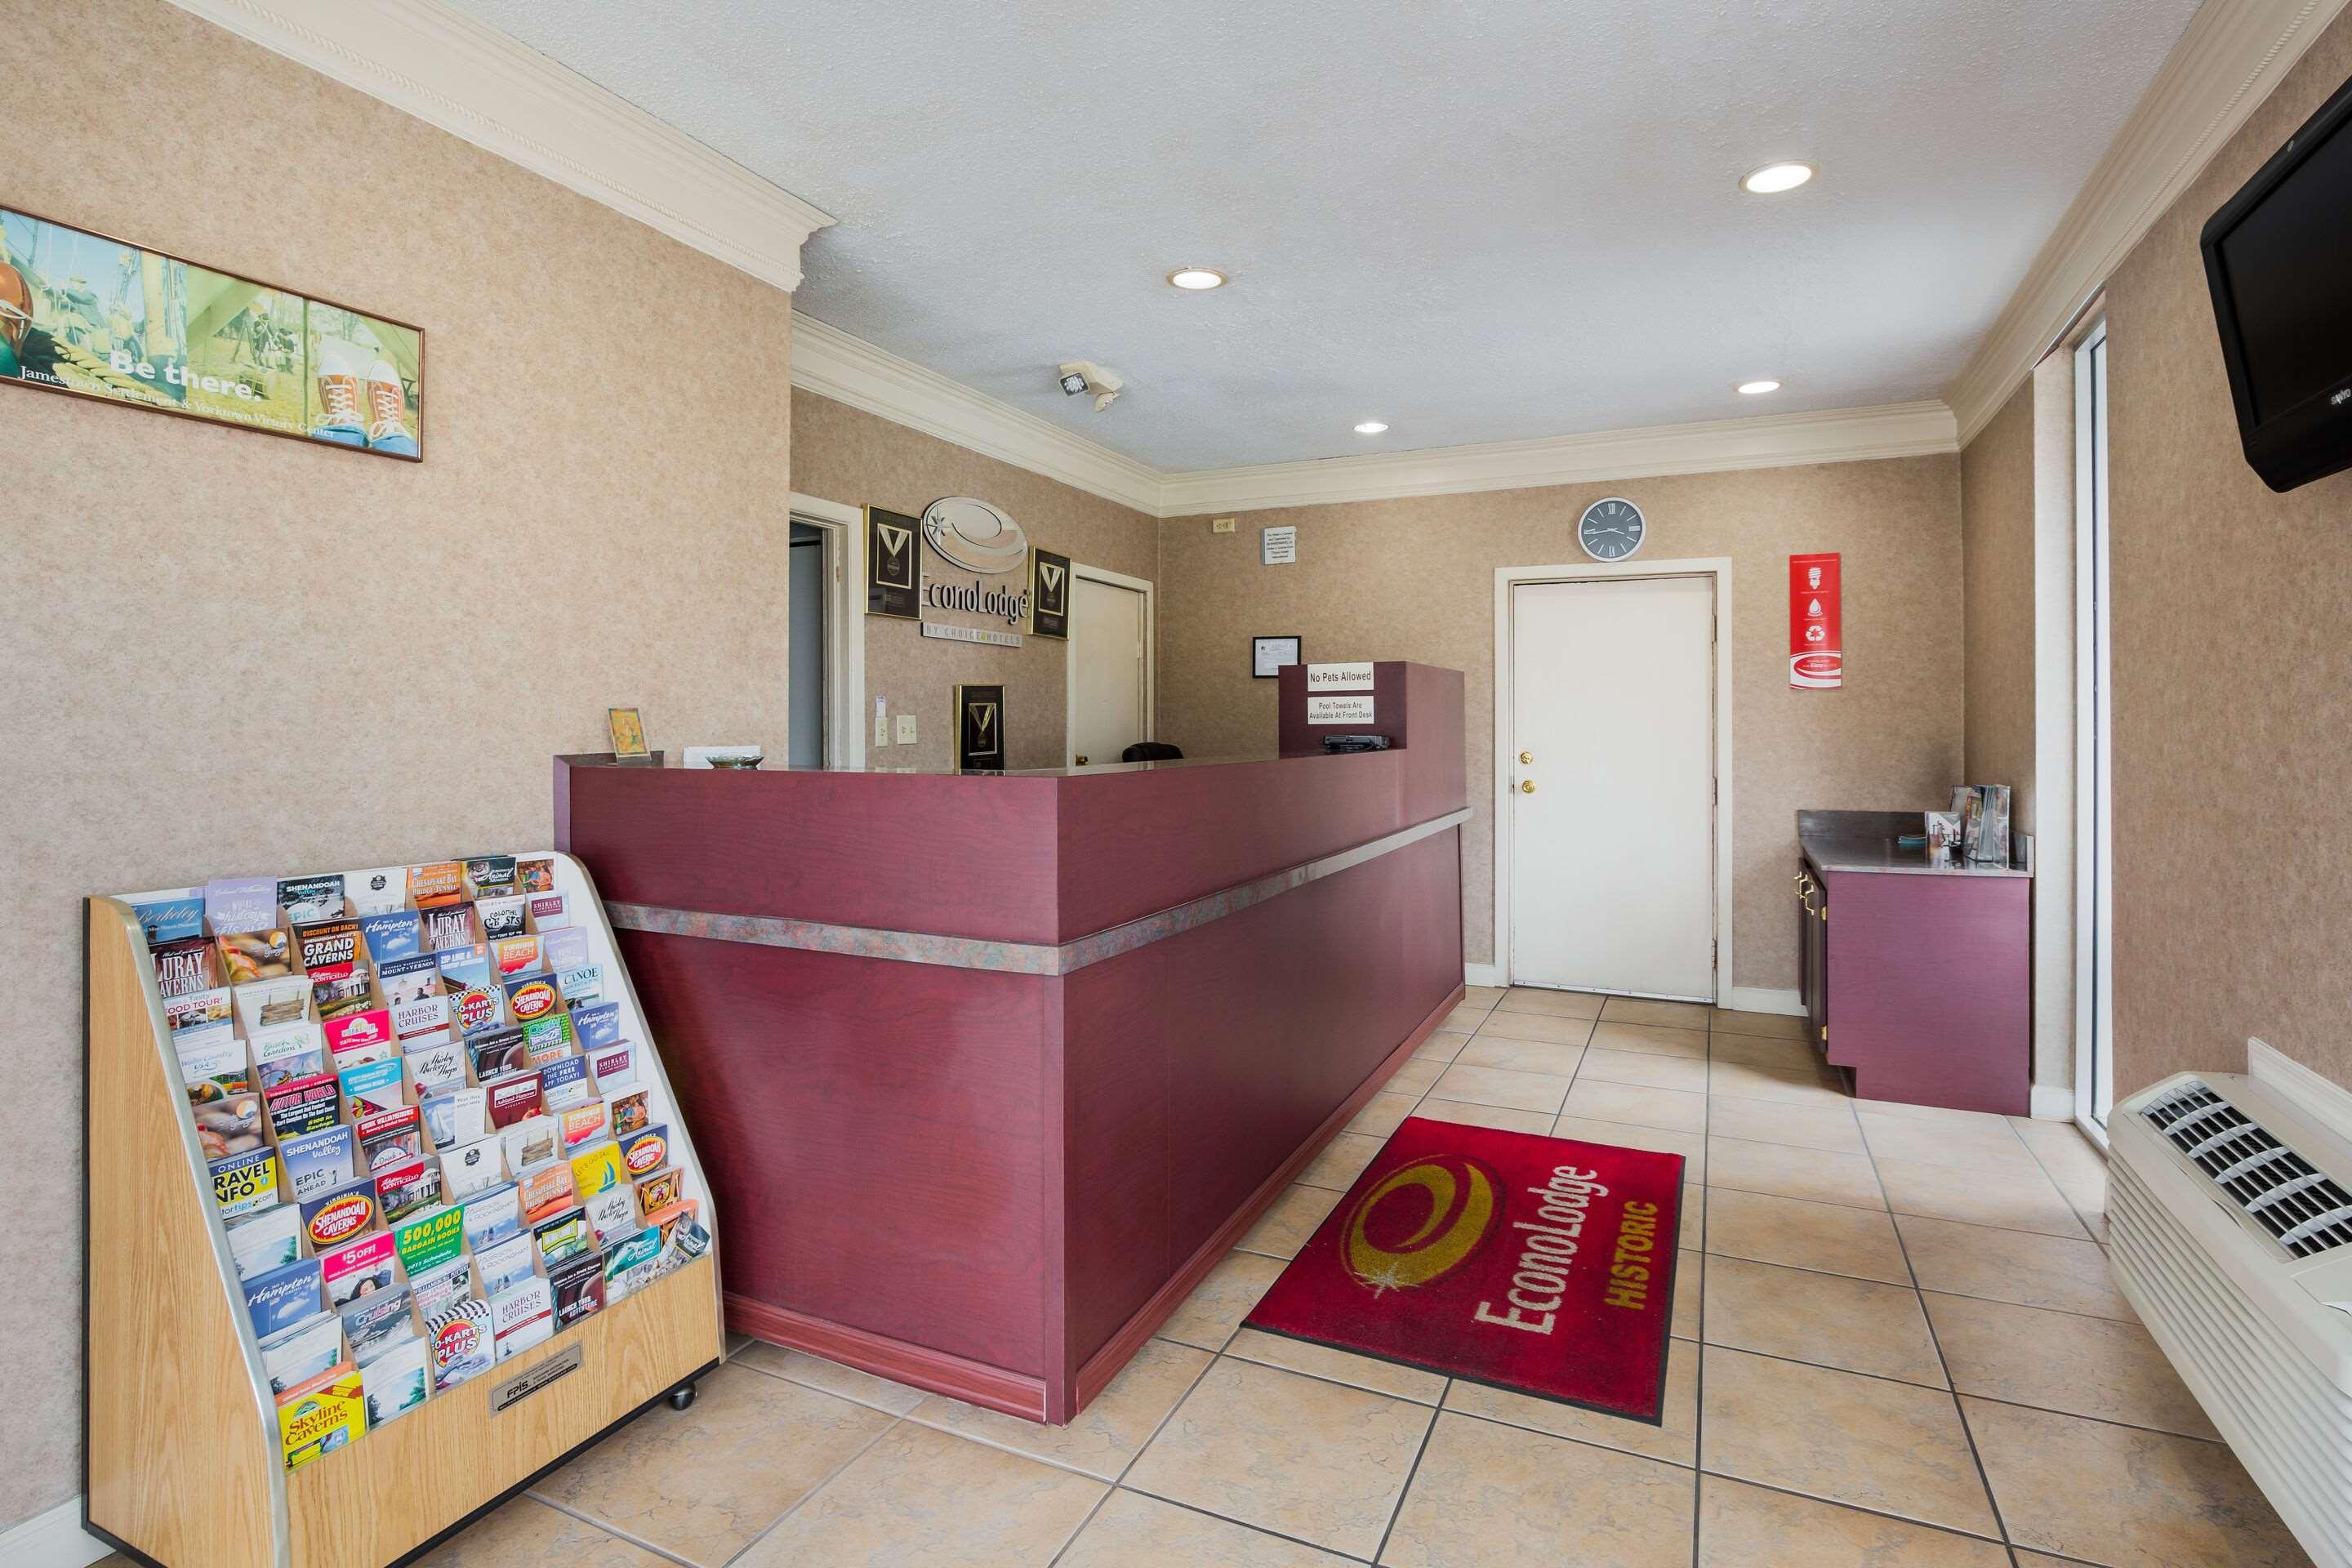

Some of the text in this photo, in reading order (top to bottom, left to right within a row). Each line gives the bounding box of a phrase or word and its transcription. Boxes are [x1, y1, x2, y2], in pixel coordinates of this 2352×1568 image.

[111, 350, 262, 403] Be there.
[18, 365, 102, 393] Jamestown
[182, 398, 192, 410] &
[194, 402, 252, 422] Yorktown
[252, 412, 295, 432] Victory
[297, 421, 335, 439] Center
[1310, 670, 1371, 683] No Pets Allowed
[287, 881, 340, 893] SHENANDOAH
[533, 899, 561, 908] SHIRLEY
[303, 926, 331, 937] DISCOUNT
[340, 923, 359, 932] BACK!
[366, 920, 412, 933] Hampton
[429, 911, 465, 937] LURAY
[304, 938, 354, 956] GRAND
[503, 947, 534, 960] BEACH
[303, 950, 354, 968] CAVERNS
[381, 967, 405, 976] MOUNT
[409, 960, 434, 971] VERNON
[158, 973, 203, 999] AVERNS
[193, 996, 223, 1009] TOUR!
[453, 996, 499, 1014] GO-KARTS
[514, 990, 550, 1010] SHENANDOAH
[519, 1000, 544, 1013] CAVERNS
[398, 1004, 439, 1020] HARBOR
[398, 1013, 439, 1028] CRUISES
[461, 1008, 493, 1022] PLUS
[578, 1011, 614, 1026] Hampton
[262, 1045, 296, 1058] Gardens
[532, 1049, 563, 1064] MORE
[543, 1058, 579, 1076] DOWNLOAD
[599, 1054, 628, 1069] SHIRLEY
[544, 1072, 580, 1089] APP TODAY!
[547, 1067, 575, 1080] THE FREE
[270, 1093, 302, 1111] MOTOR
[304, 1085, 336, 1102] WORLD
[568, 1114, 601, 1131] BEACH
[287, 1131, 349, 1157] SHENANDOAH
[312, 1145, 341, 1159] valley
[217, 1154, 261, 1174] ONLINE
[214, 1162, 270, 1190] RAVEL
[296, 1169, 325, 1186] EPIC
[382, 1174, 419, 1192] MONTICELLO
[216, 1182, 255, 1203] NFO
[297, 1179, 327, 1196] AHEAD
[314, 1200, 366, 1234] SHENANDOAH
[322, 1215, 357, 1239] CAVERNS
[403, 1209, 461, 1245] 500,000
[401, 1237, 435, 1255] BARGAIN
[436, 1226, 461, 1241] BOOKS
[342, 1243, 376, 1265] $5 OFF!
[1472, 1165, 1610, 1336] EconoLodge
[1604, 1200, 1659, 1311] HISTORIC
[247, 1273, 313, 1307] Hampton
[502, 1290, 541, 1315] HARBOR
[502, 1299, 542, 1324] CRUISES
[435, 1338, 479, 1364] PLUS
[289, 1401, 346, 1432] Skyline
[285, 1410, 349, 1446] Caverns
